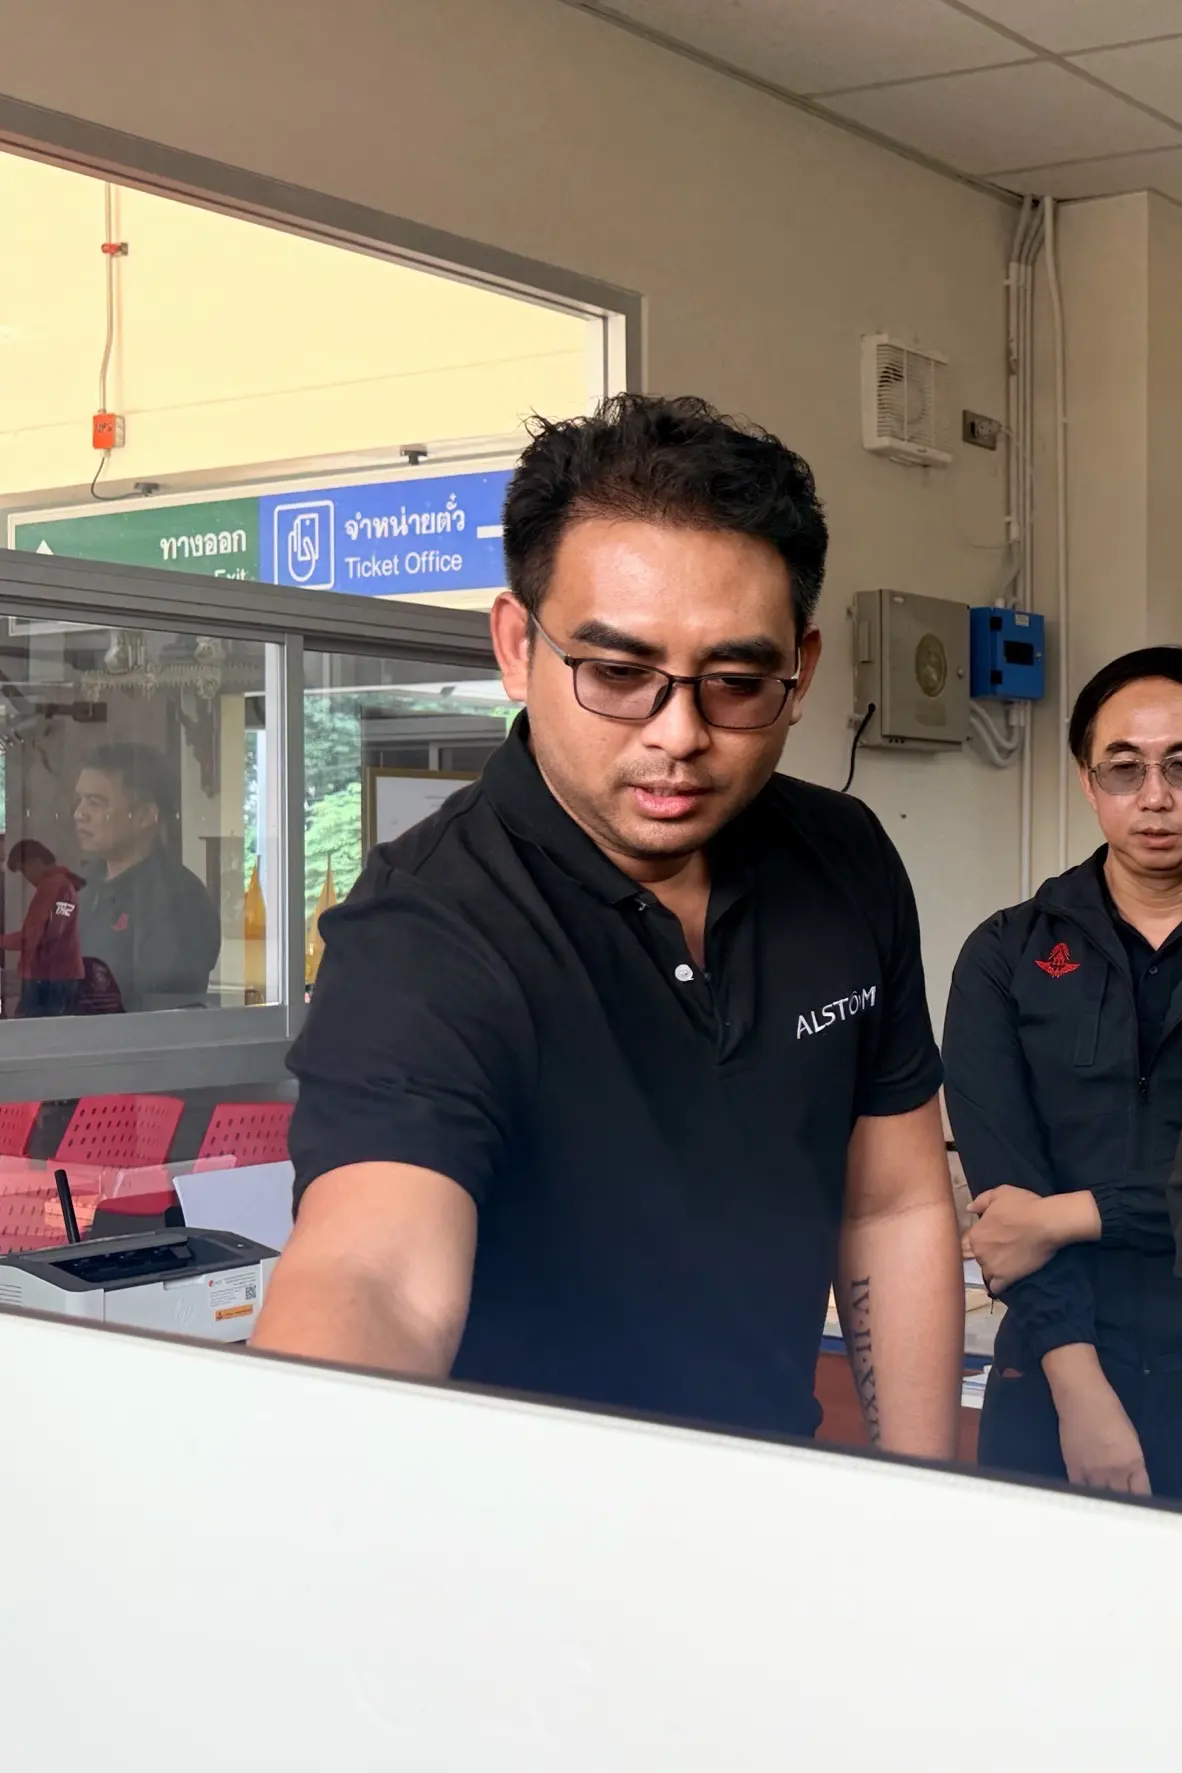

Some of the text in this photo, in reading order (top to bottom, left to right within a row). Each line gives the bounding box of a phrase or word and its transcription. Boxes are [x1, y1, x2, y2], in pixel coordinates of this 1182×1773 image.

[344, 492, 466, 541] จำหน่ายตั๋ว
[159, 528, 247, 560] ทางออก
[344, 550, 463, 579] Ticket Office
